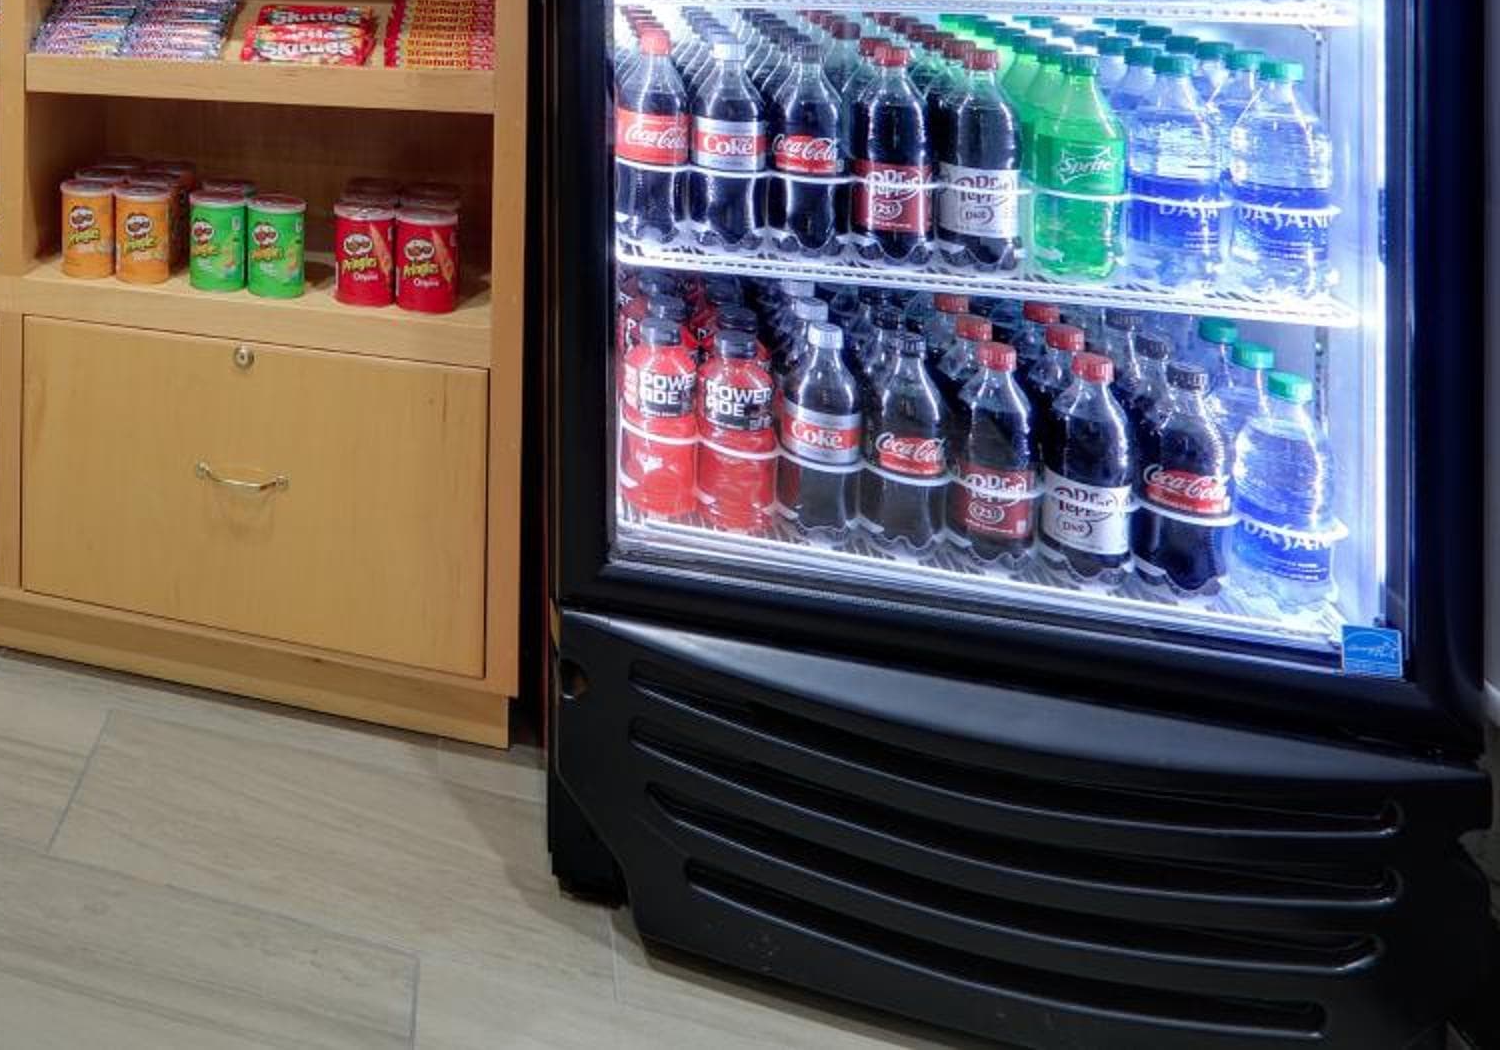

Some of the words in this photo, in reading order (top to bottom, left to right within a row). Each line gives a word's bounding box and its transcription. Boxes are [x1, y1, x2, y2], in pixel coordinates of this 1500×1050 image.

[270, 10, 361, 25] Skittles
[260, 40, 355, 57] Skittles
[703, 135, 753, 156] Coke
[773, 133, 839, 161] Coca-Cola
[1058, 154, 1114, 174] Sprite
[883, 169, 907, 183] Dr
[975, 175, 998, 189] Dr
[342, 257, 377, 274] Pringles
[791, 419, 843, 448] Coke
[875, 431, 945, 463] Coca-Cola
[987, 474, 1010, 490] Dr
[1142, 463, 1230, 500] Coca-Cola
[1073, 488, 1098, 502] Dr
